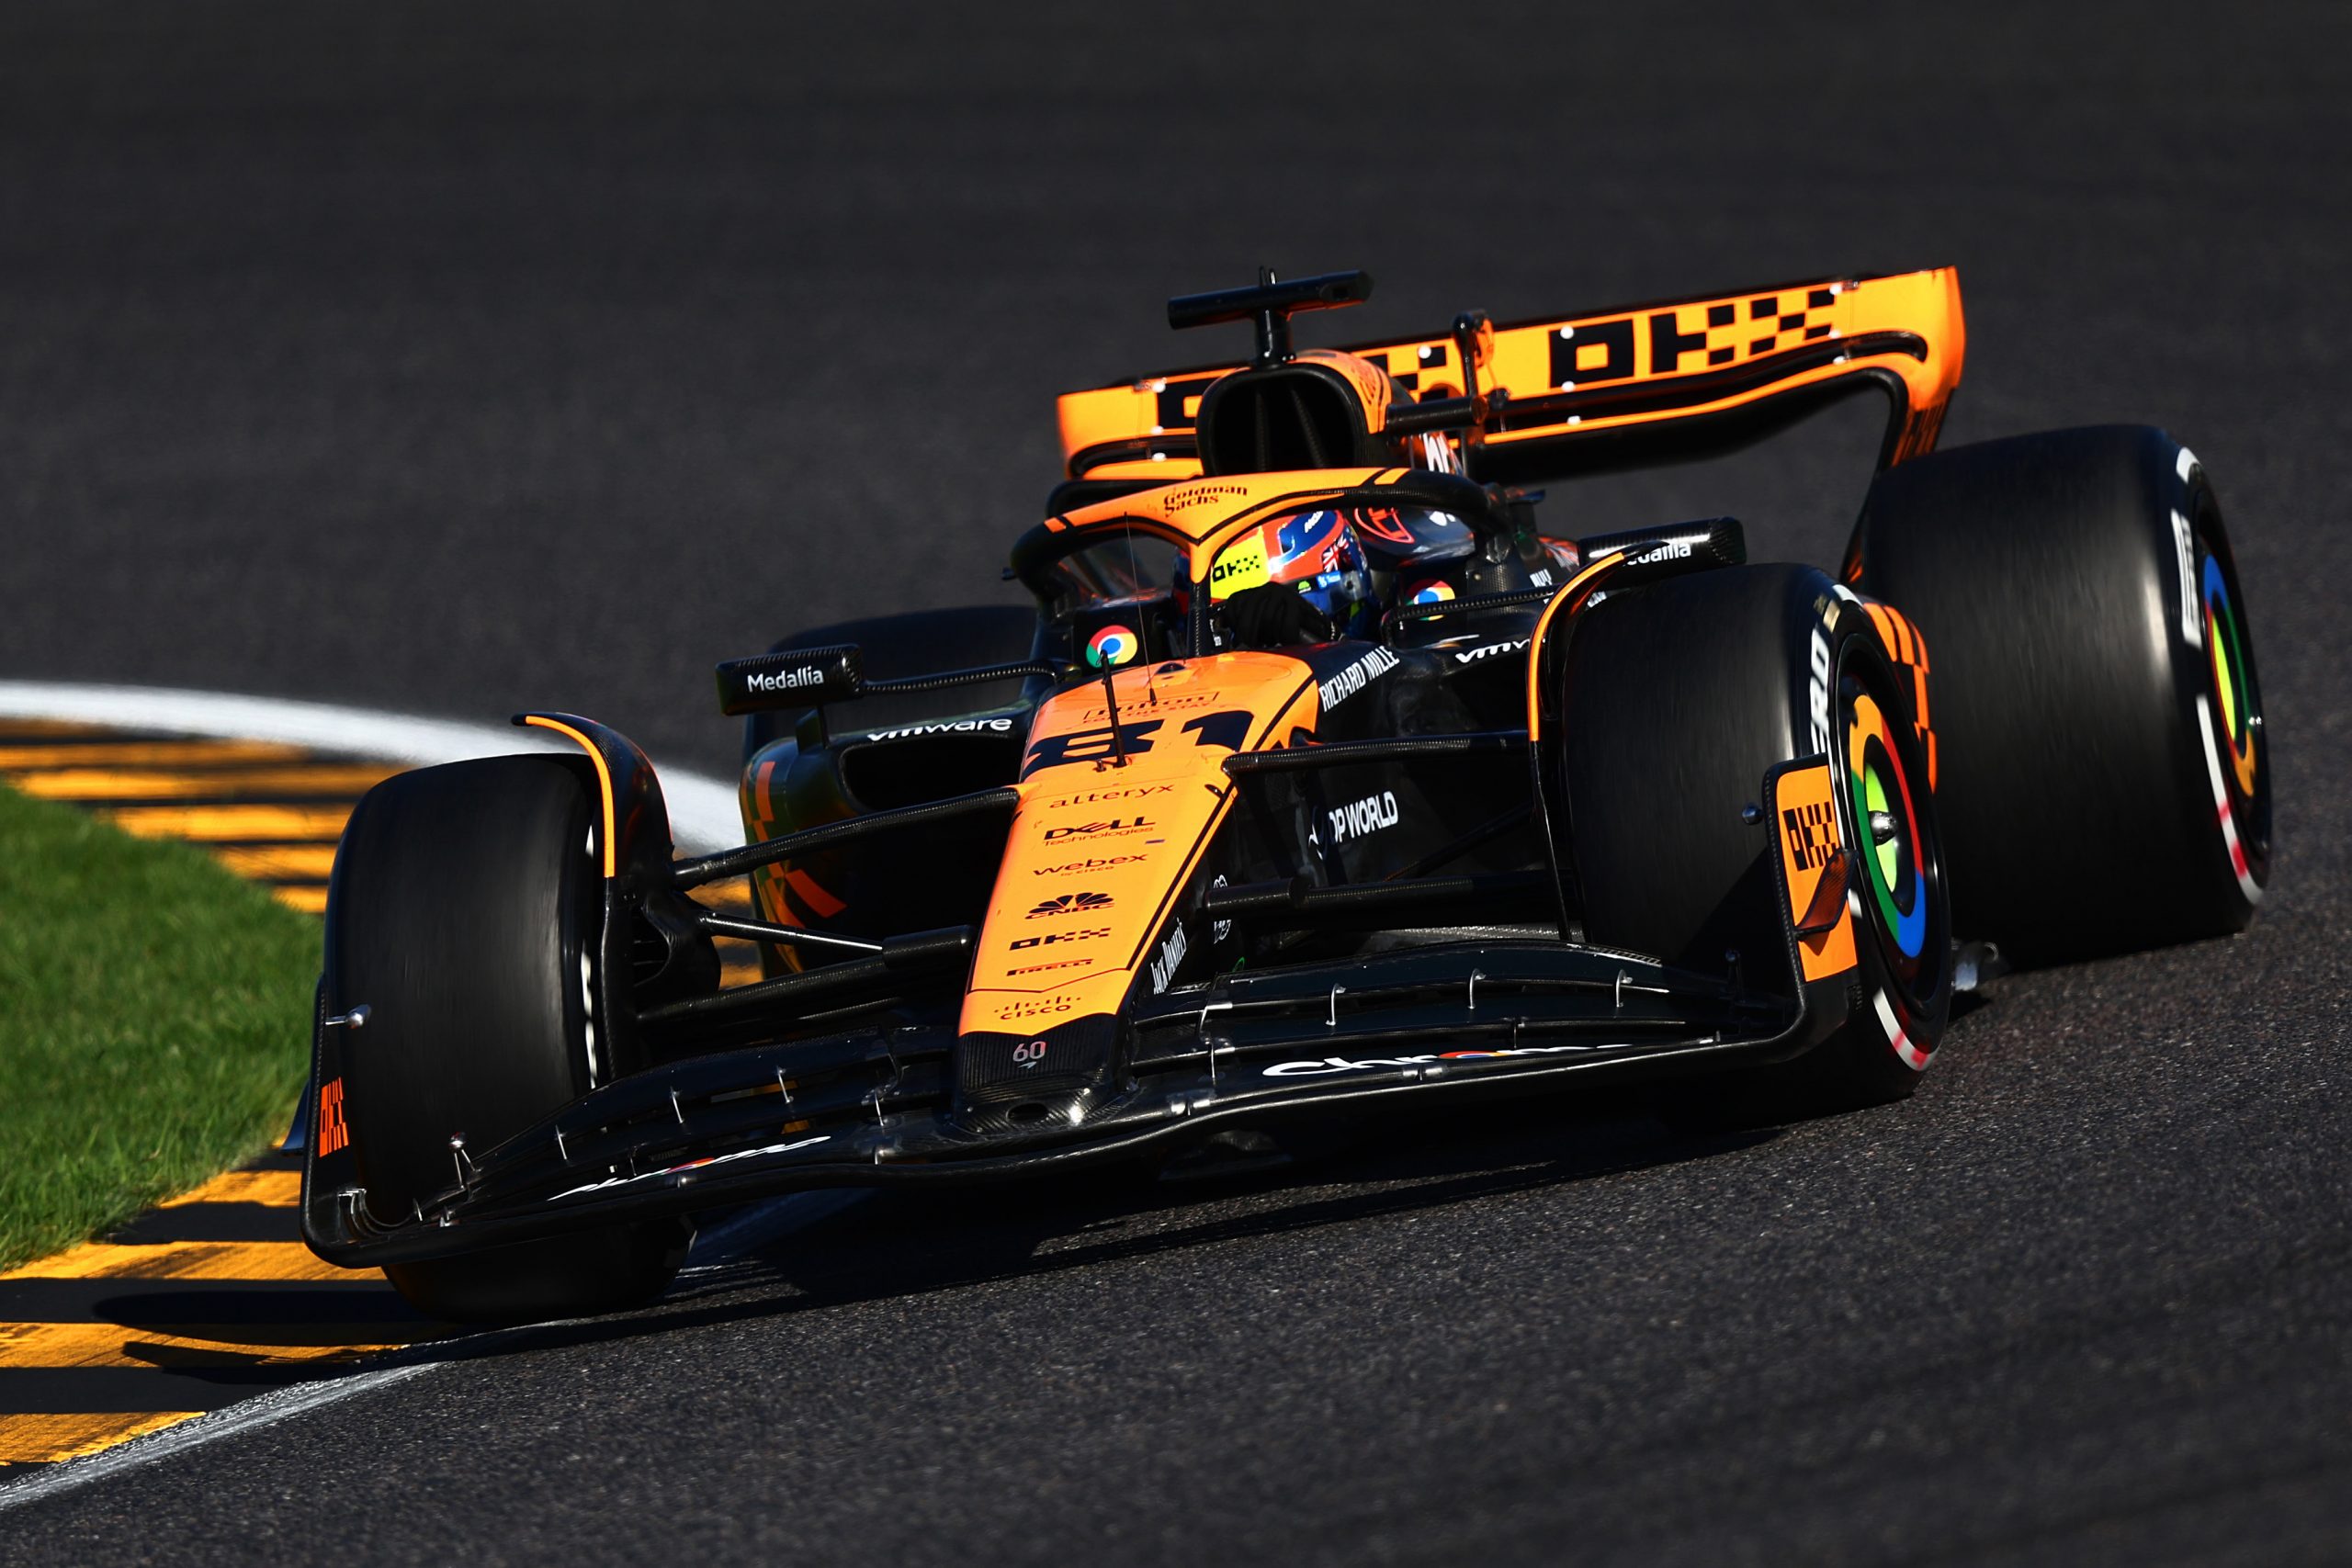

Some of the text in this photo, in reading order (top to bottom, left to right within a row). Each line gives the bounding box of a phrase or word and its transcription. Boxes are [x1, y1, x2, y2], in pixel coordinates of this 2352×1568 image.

[1548, 288, 1837, 389] OKX
[1163, 484, 1248, 506] Goldman
[1164, 494, 1220, 517] Sachs
[1211, 555, 1261, 583] OKX
[747, 665, 824, 693] Medallia
[1318, 645, 1400, 713] RICHARD MILLE
[867, 716, 1013, 742] vmware
[1049, 784, 1175, 808] alteryx
[1344, 790, 1398, 839] WORLD
[1044, 816, 1156, 840] DELL
[1044, 826, 1155, 847] Technologies
[1034, 853, 1148, 876] webex
[1024, 903, 1115, 919] CNBC
[1009, 927, 1112, 951] OKX
[1000, 1004, 1071, 1021] cisco
[1012, 1041, 1046, 1063] 60
